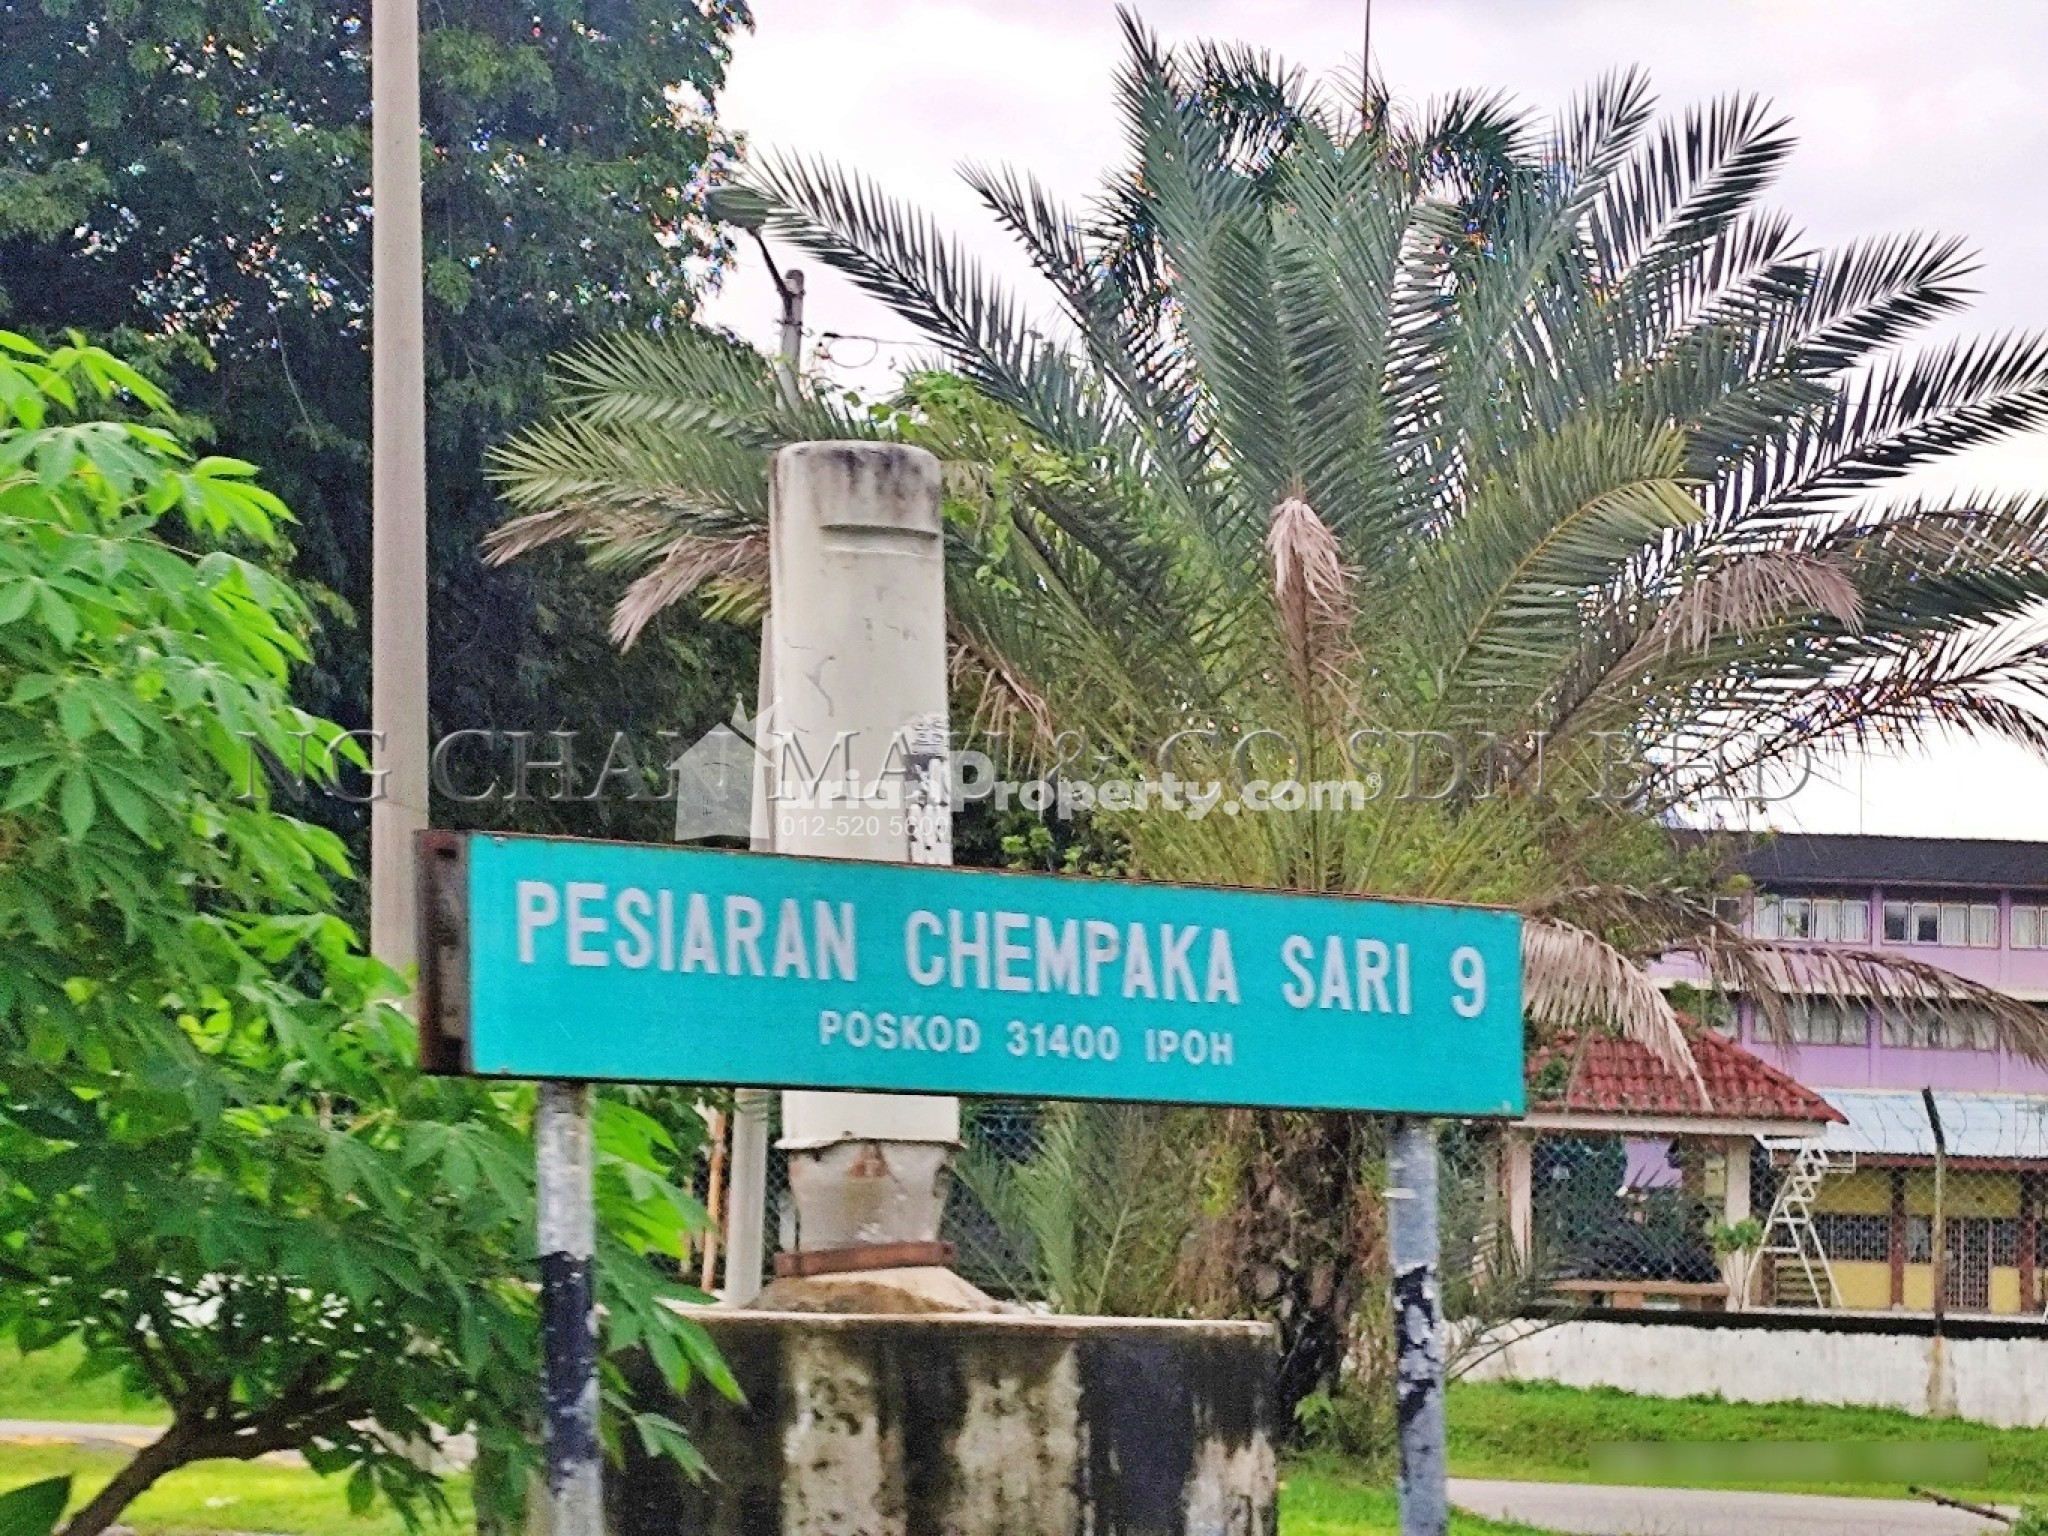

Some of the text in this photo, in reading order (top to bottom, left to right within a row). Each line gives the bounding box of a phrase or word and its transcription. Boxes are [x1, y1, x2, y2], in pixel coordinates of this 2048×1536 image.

[516, 880, 1488, 1018] PESIARAN CHEMPAKA SARI 9
[818, 1009, 1234, 1066] POSKOD 31400 IPOH
